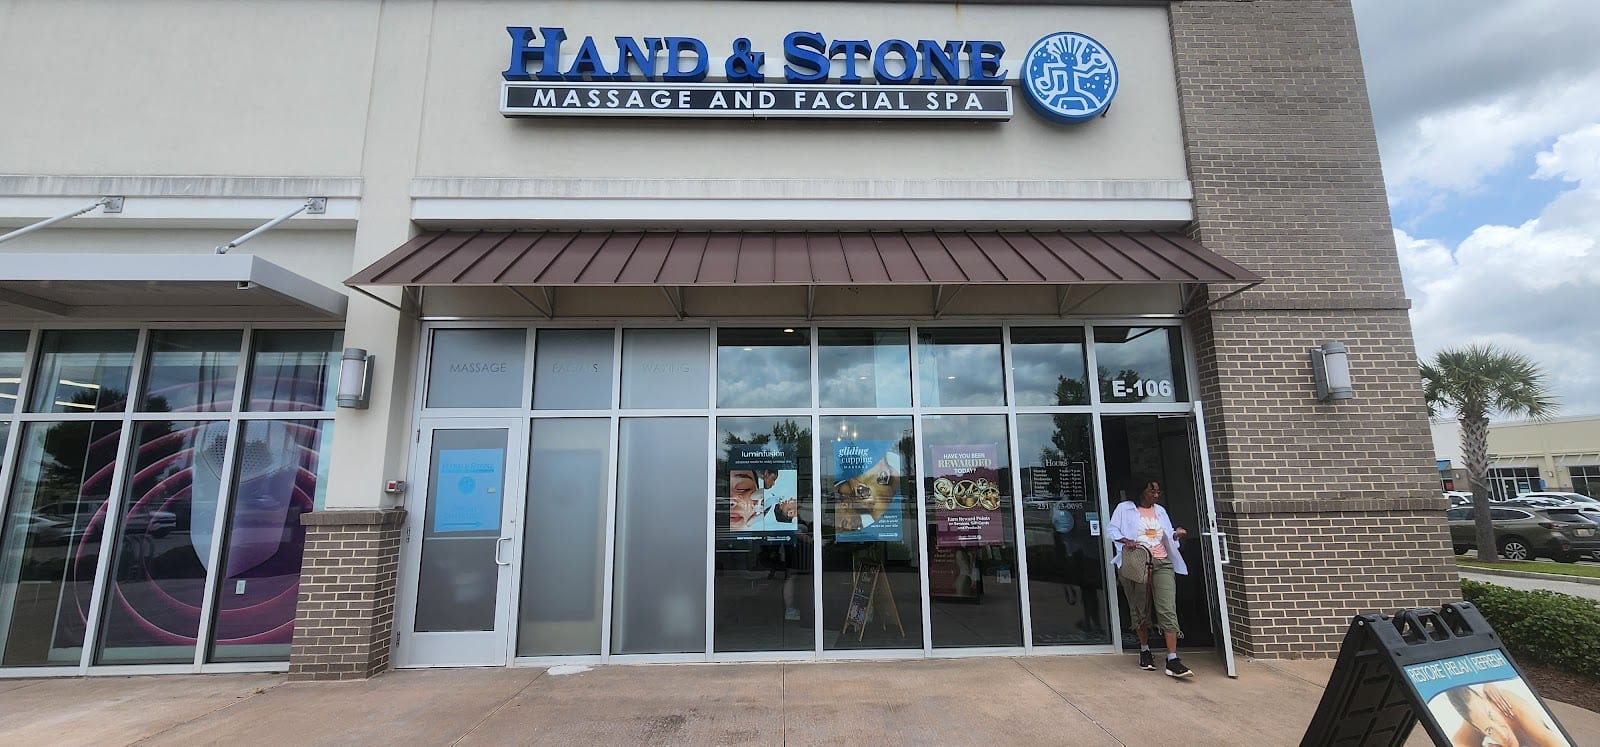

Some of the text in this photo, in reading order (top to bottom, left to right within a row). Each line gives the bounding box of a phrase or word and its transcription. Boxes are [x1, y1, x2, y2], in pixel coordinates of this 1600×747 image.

[502, 26, 1009, 84] HAND & STONE
[532, 88, 984, 110] MASSAGE AND FACIAL SPA
[449, 362, 508, 374] MASSAGE
[1112, 380, 1172, 397] E-106
[838, 446, 870, 457] gliding
[841, 456, 873, 465] cupping
[938, 459, 992, 468] REWARDED
[1408, 653, 1505, 683] RESTORE RELAX REFRESH
